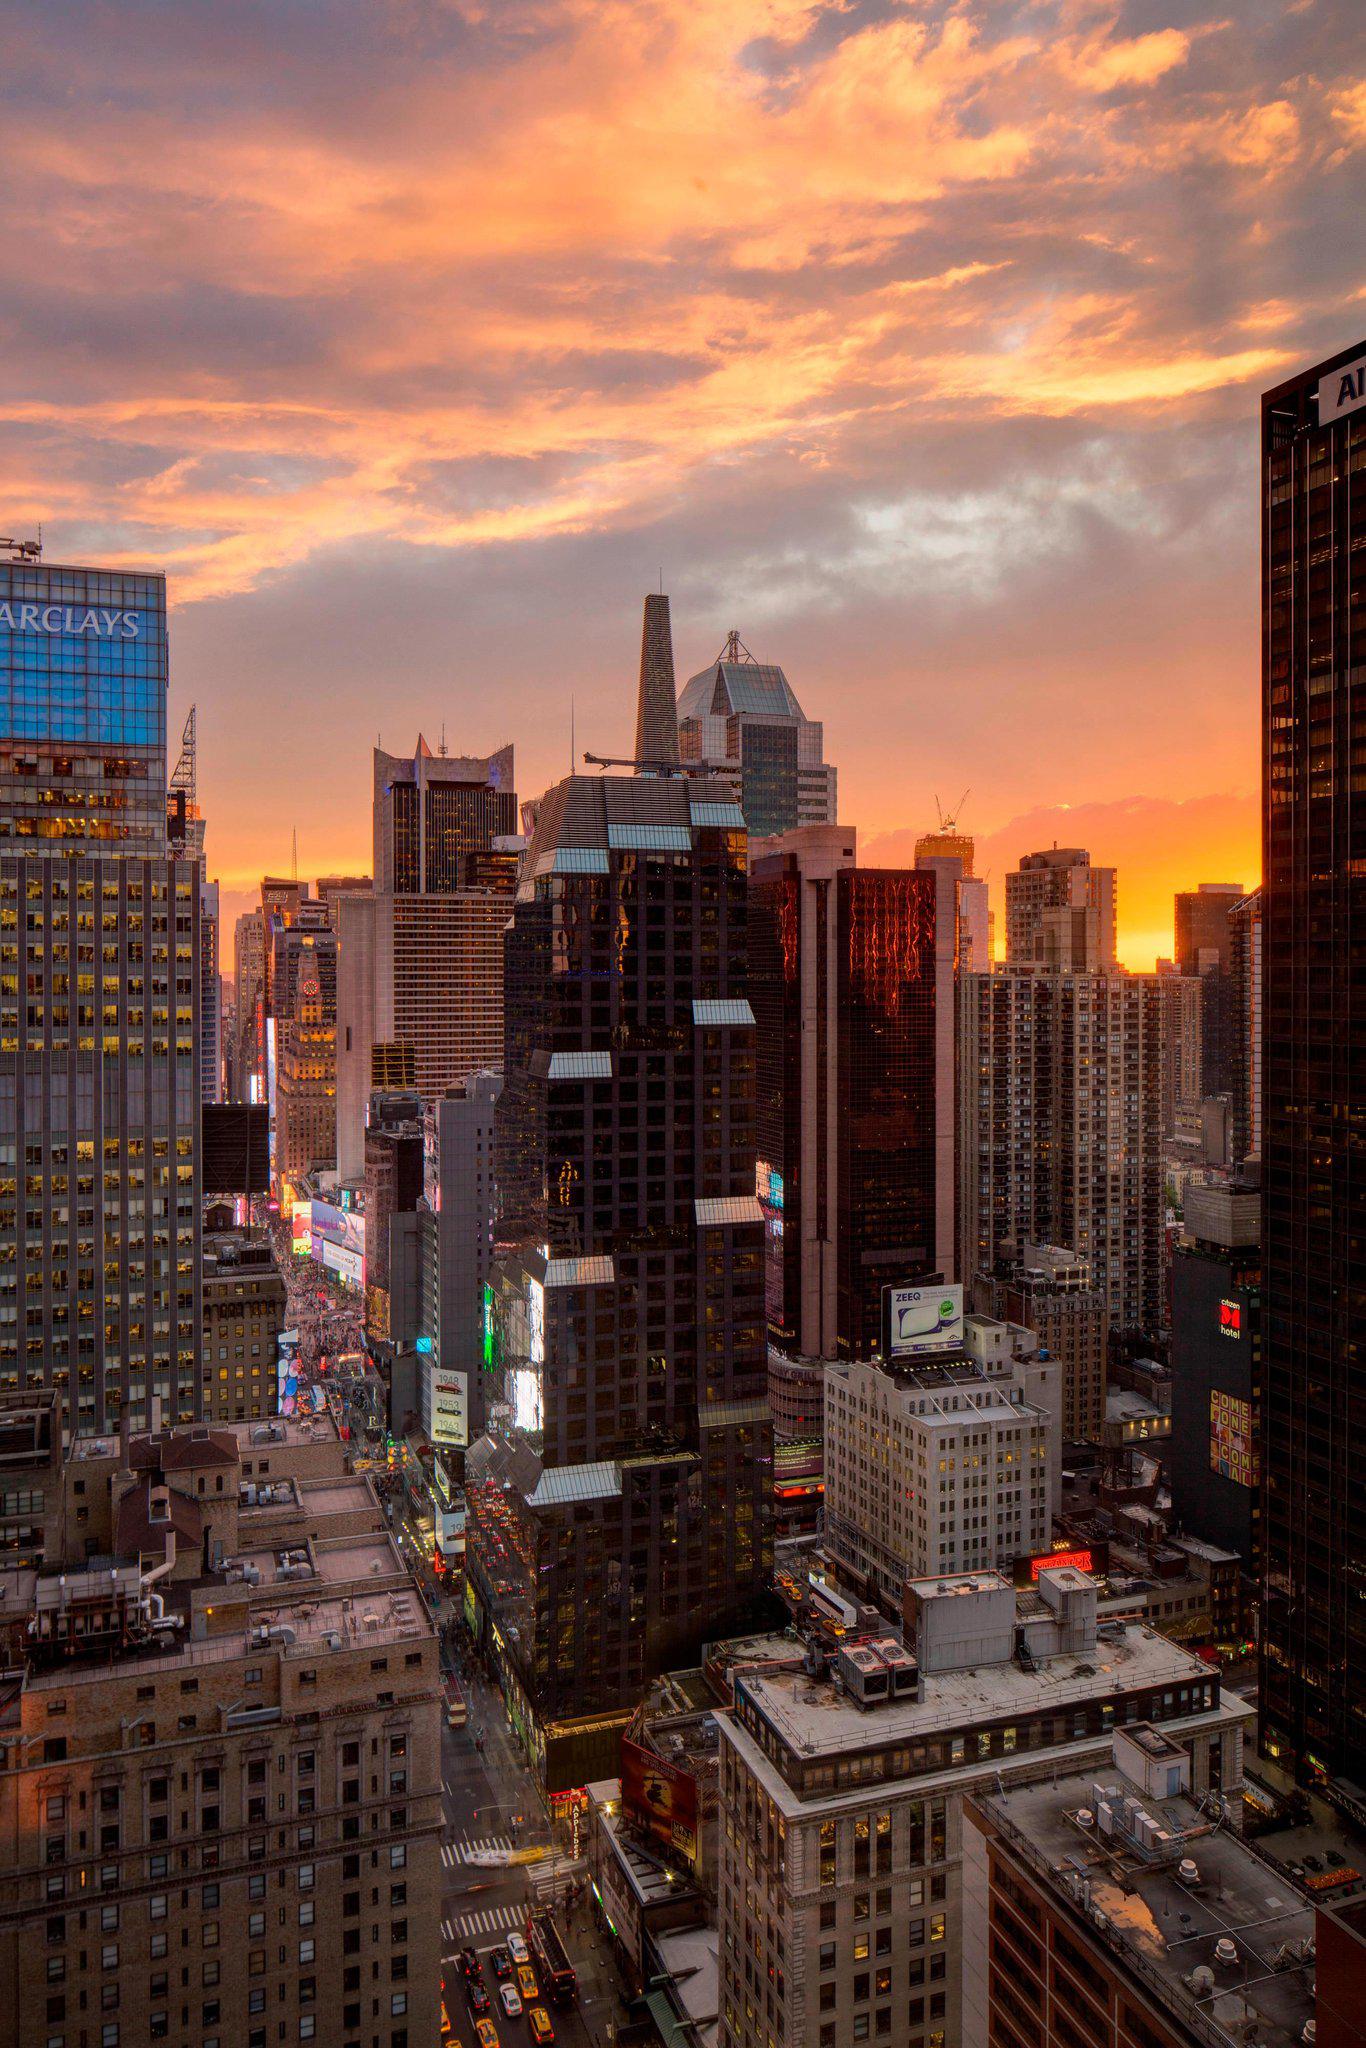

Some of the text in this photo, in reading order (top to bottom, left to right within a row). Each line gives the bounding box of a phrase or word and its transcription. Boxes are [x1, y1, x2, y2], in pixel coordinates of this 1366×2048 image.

[895, 1291, 922, 1302] ZEEQ
[1220, 1298, 1241, 1310] citizen
[1220, 1324, 1240, 1340] hotel
[439, 1398, 459, 1409] 1953
[1210, 1389, 1250, 1417] COME
[439, 1419, 459, 1430] 1963
[1220, 1410, 1250, 1435] ONE
